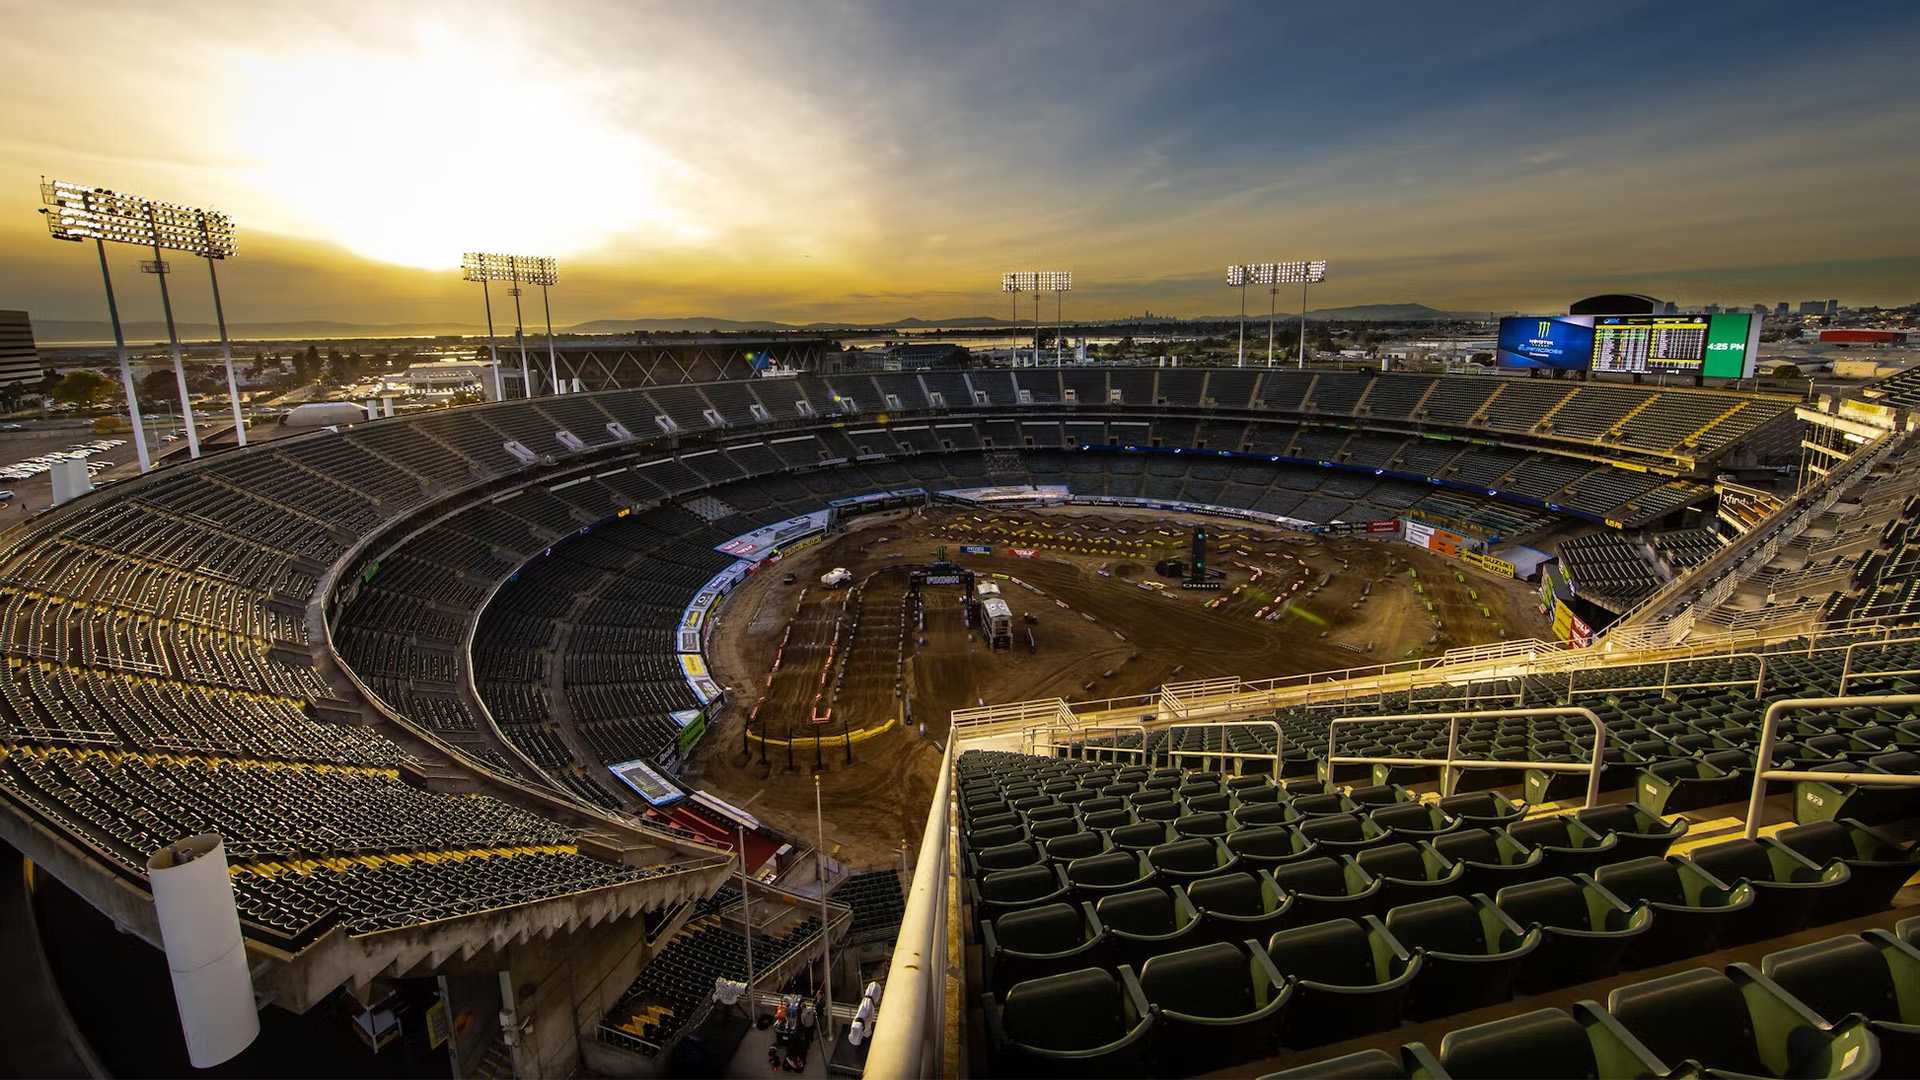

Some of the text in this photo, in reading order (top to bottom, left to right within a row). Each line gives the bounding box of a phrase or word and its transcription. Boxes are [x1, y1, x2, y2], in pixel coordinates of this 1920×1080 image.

[1707, 342, 1744, 351] 4:25 PM
[1483, 562, 1512, 576] SUZUKI
[1484, 556, 1513, 570] SUZUKI
